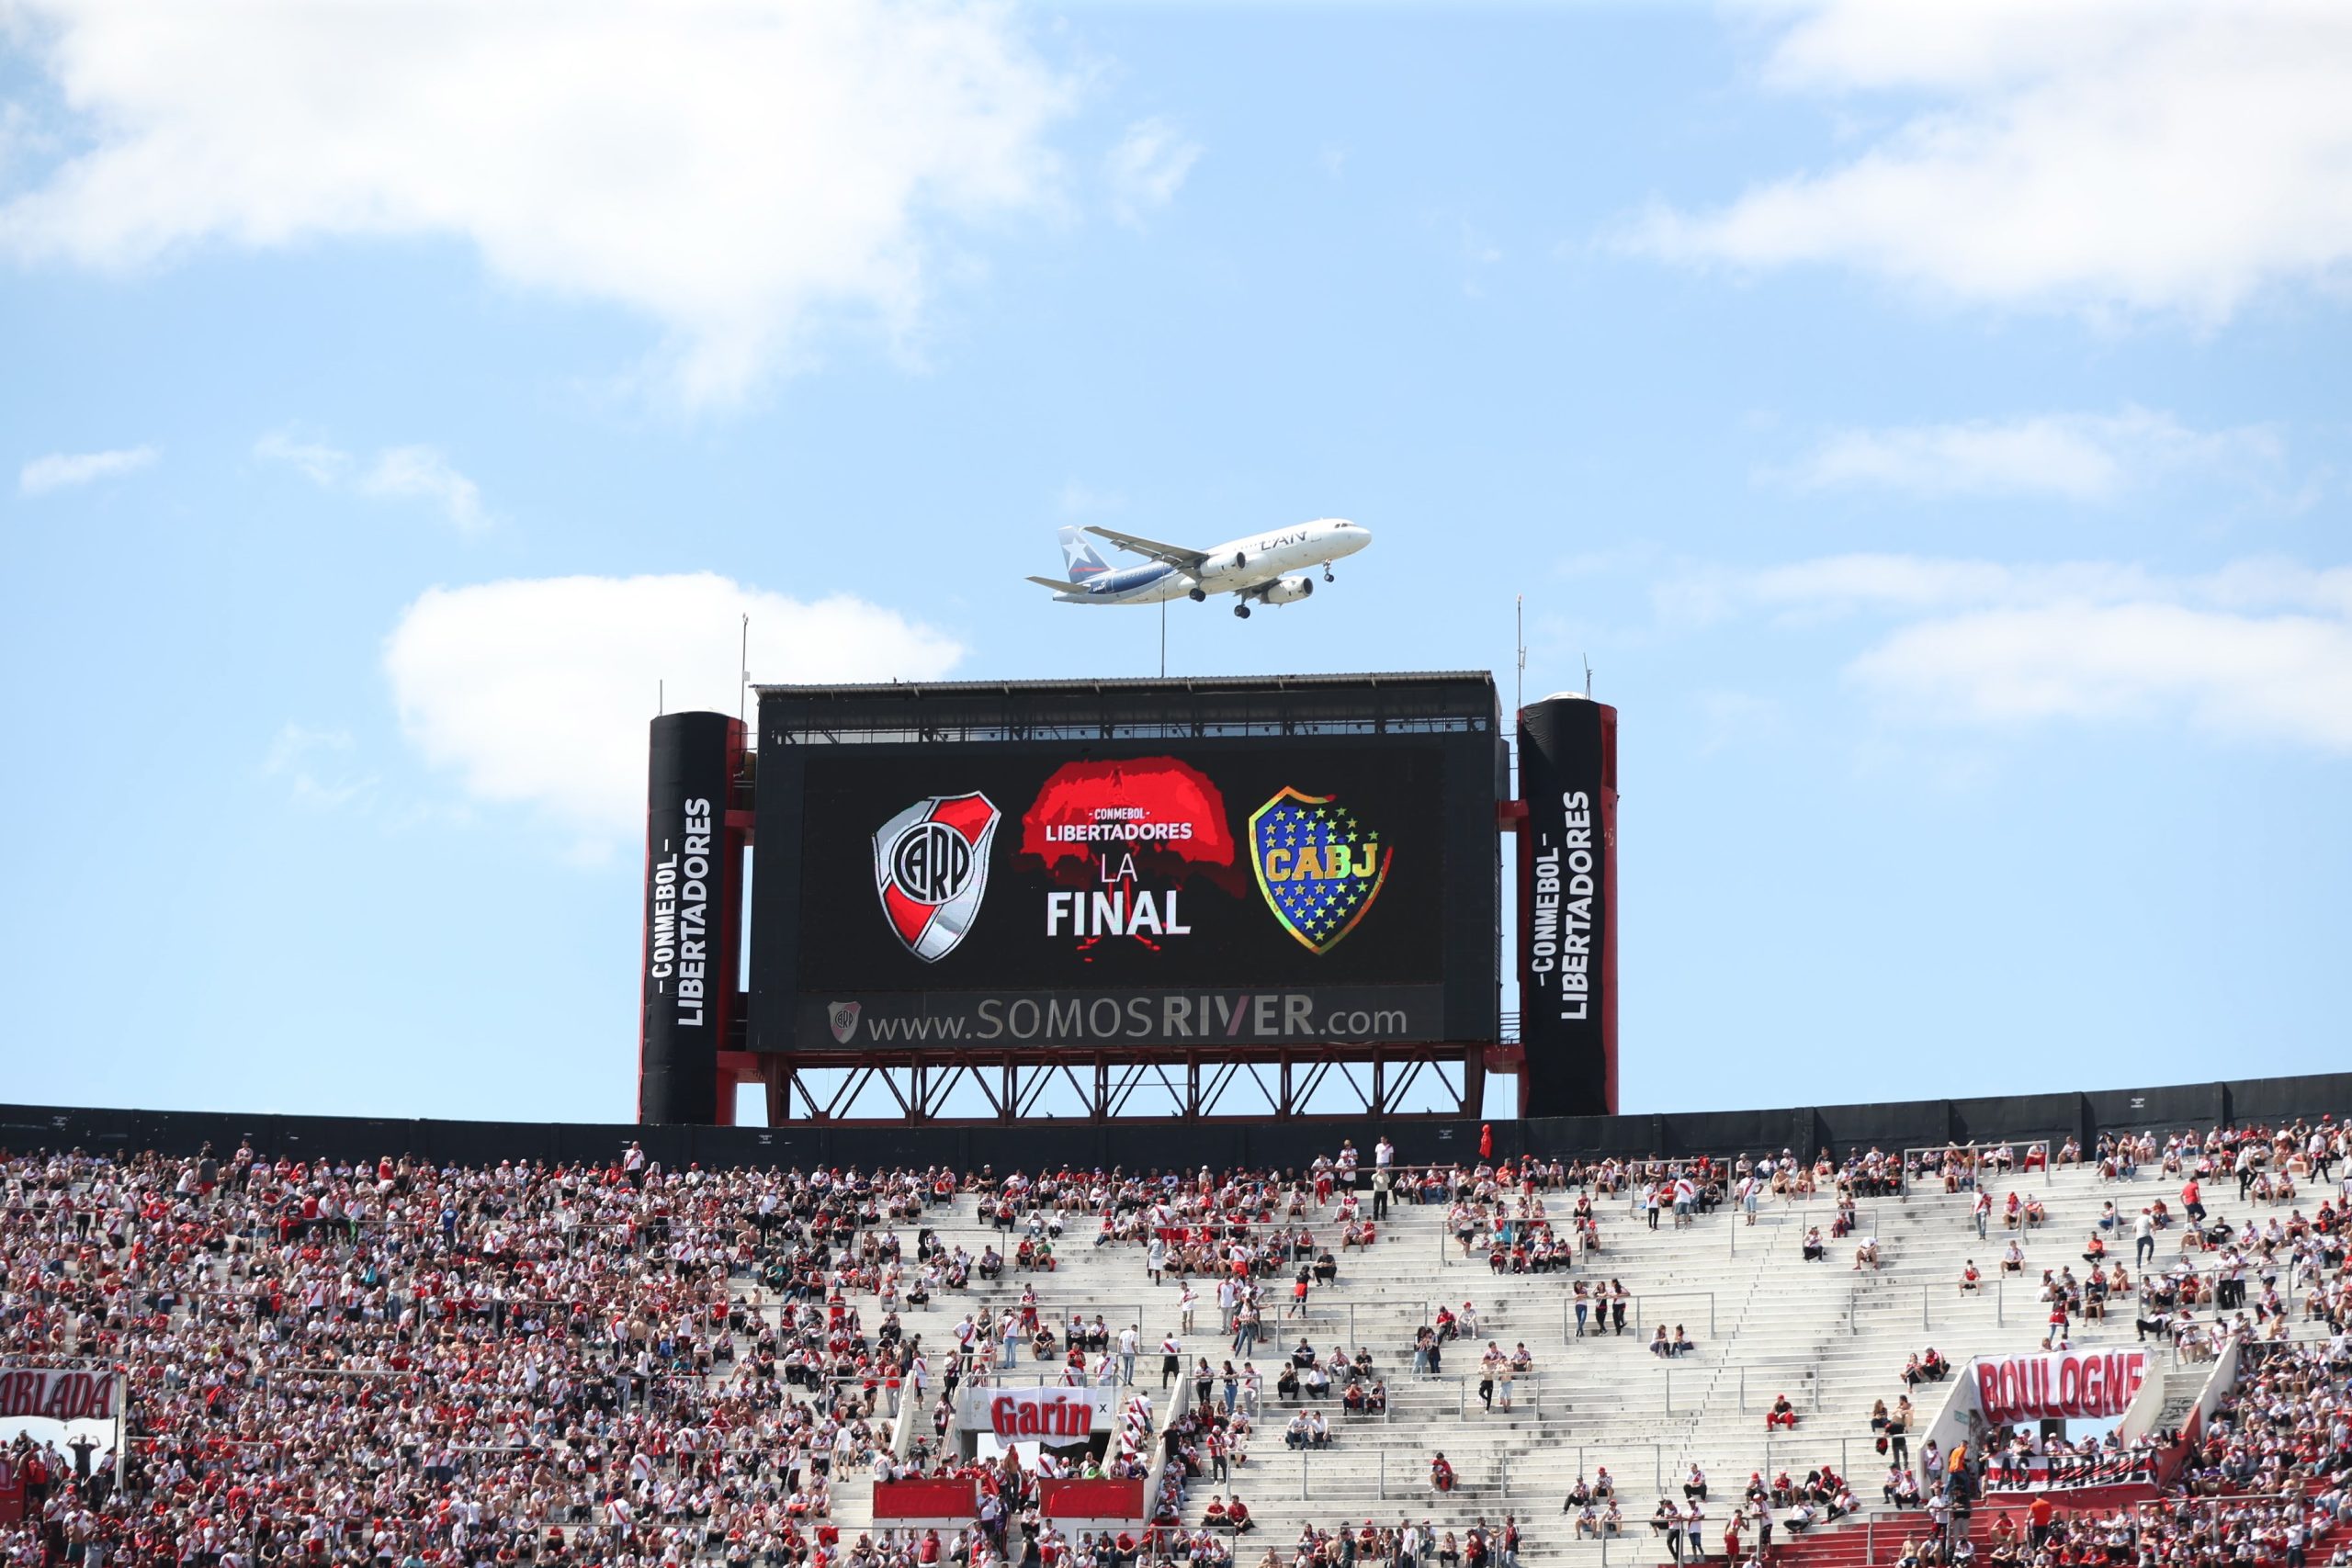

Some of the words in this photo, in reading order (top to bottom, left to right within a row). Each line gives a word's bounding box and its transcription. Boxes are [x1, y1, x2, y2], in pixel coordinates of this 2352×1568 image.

[1260, 530, 1307, 551] LAN
[1046, 823, 1193, 841] LIBERTADORES
[1102, 852, 1138, 883] LA
[1266, 842, 1378, 882] CABJ
[677, 797, 711, 1027] LIBERTADORES
[1047, 890, 1192, 937] FINAL
[1561, 791, 1594, 1020] LIBERTADORES
[868, 994, 1408, 1043] www.SOMOSRIVER.com
